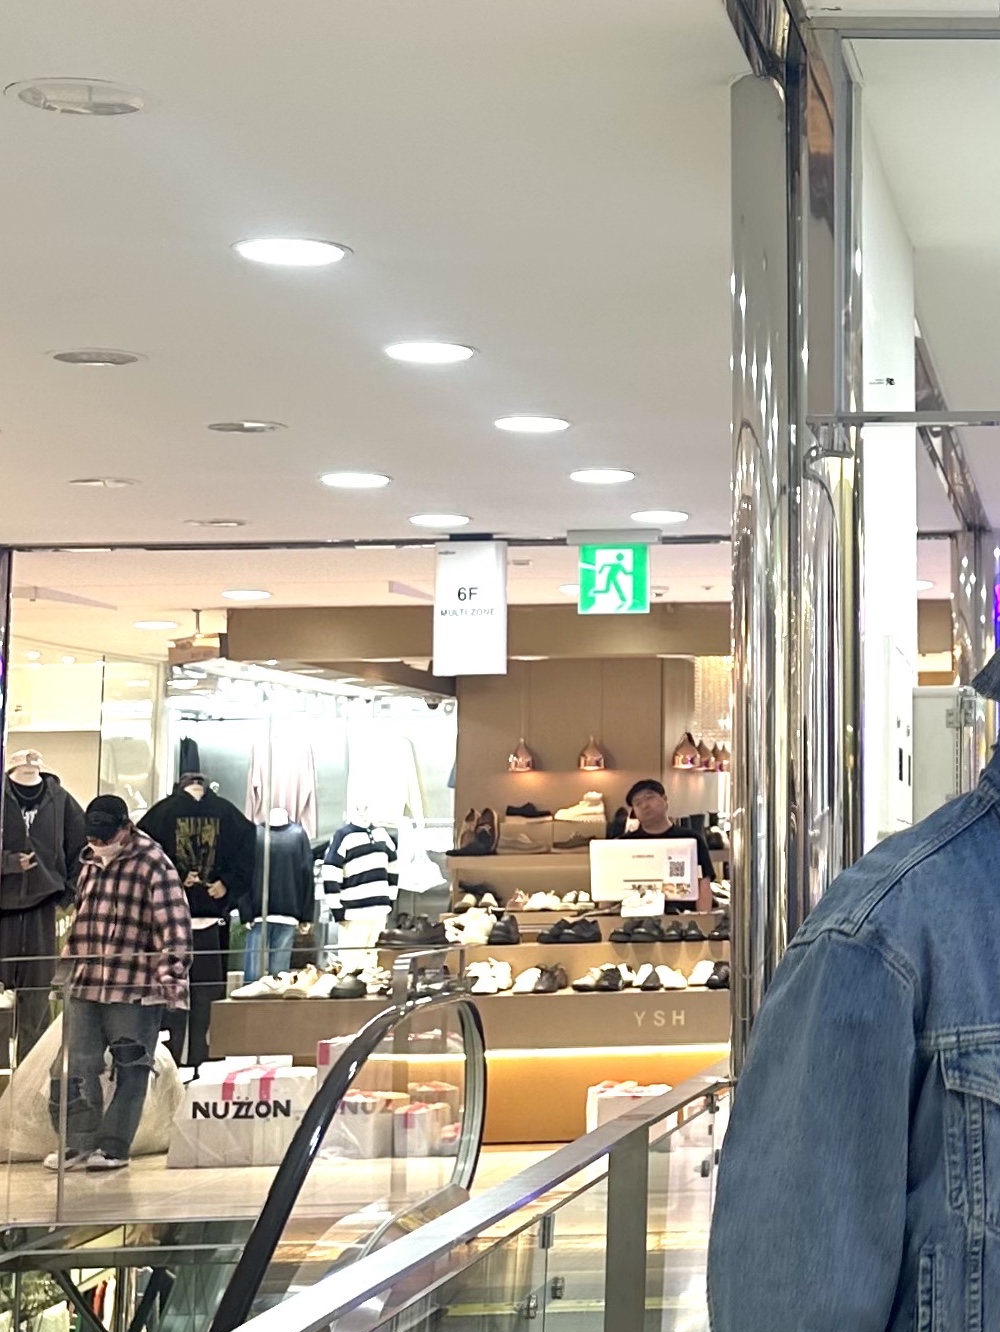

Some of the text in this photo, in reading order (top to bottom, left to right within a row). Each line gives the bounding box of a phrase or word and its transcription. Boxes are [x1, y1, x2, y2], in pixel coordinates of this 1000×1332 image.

[457, 587, 478, 601] 6F
[440, 608, 495, 617] MULTI ZONE
[633, 1010, 685, 1026] YSH
